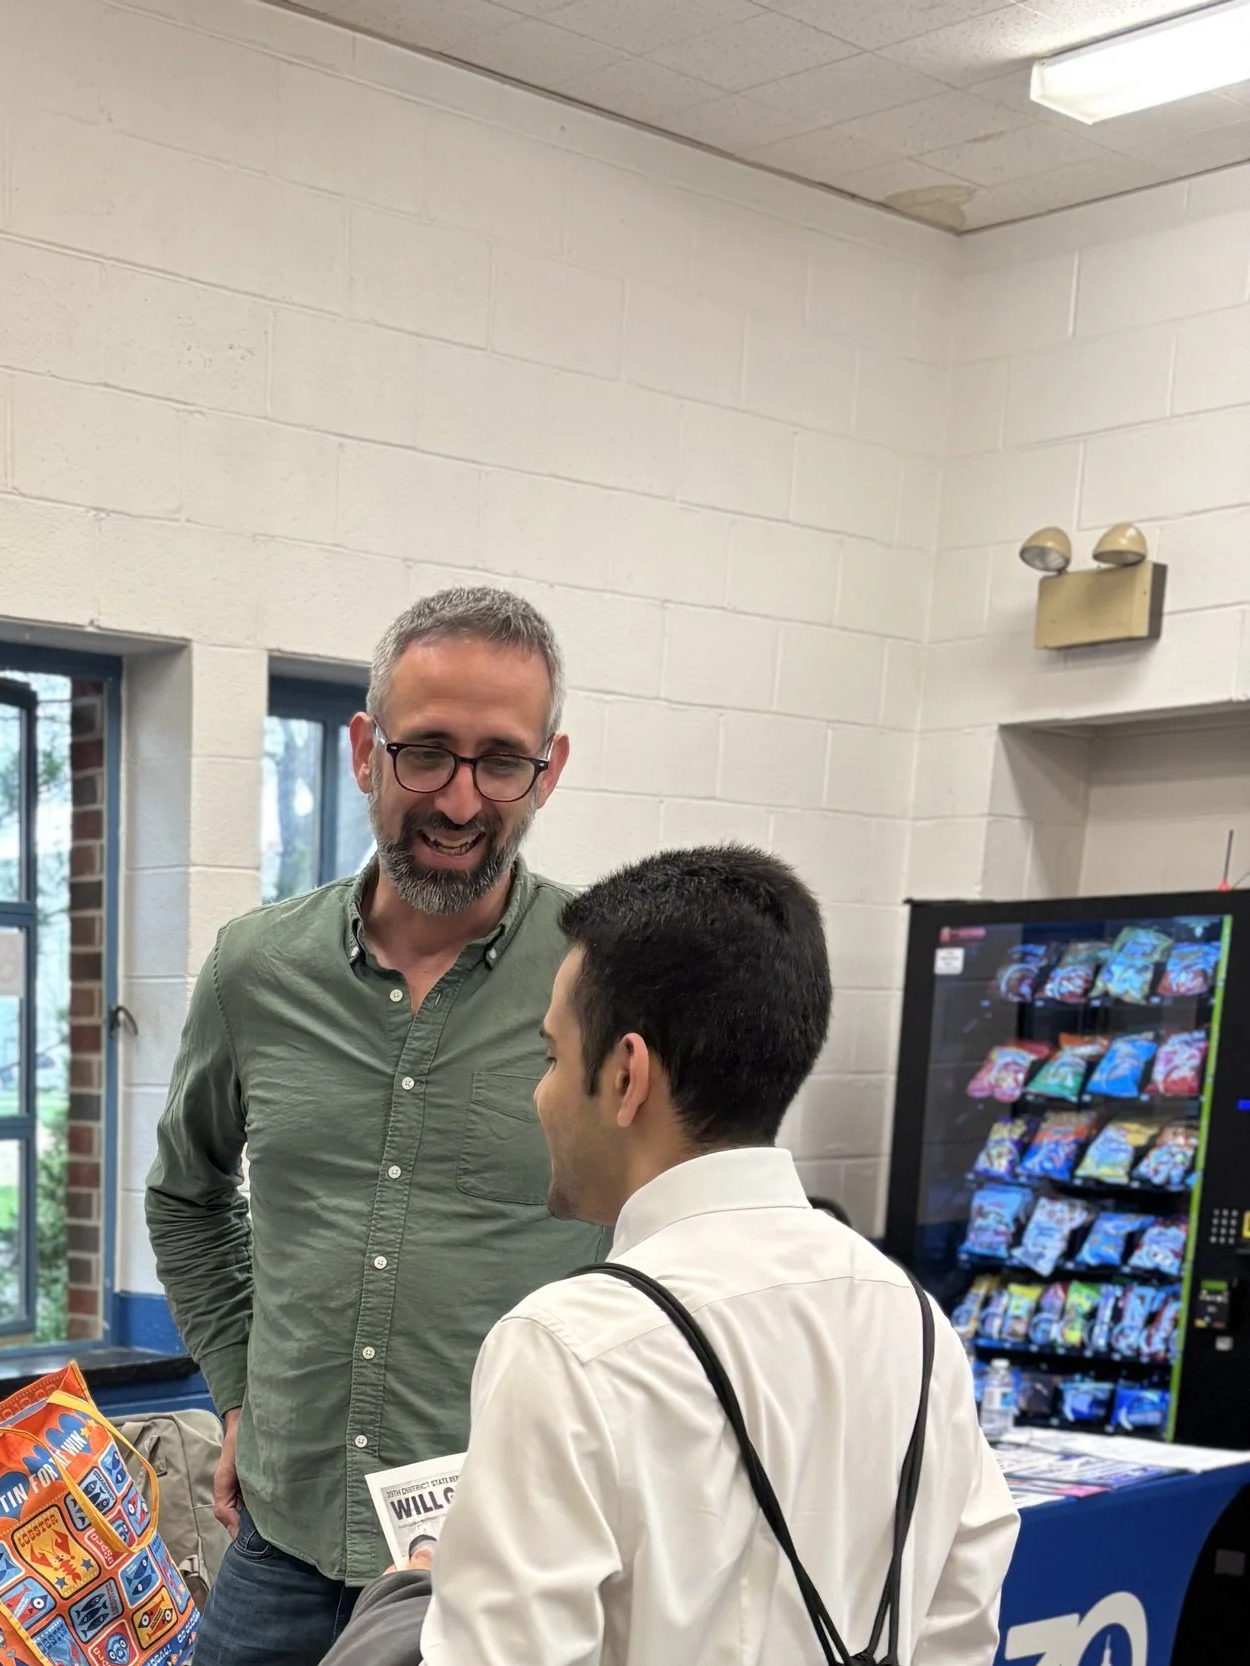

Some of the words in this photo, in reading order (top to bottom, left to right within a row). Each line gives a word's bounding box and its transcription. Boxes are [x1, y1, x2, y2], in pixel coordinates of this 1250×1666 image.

[30, 1464, 58, 1494] FOR
[61, 1430, 87, 1456] WIN
[401, 1482, 430, 1495] DISTRICT
[431, 1477, 448, 1487] STATE
[390, 1491, 444, 1520] WILL
